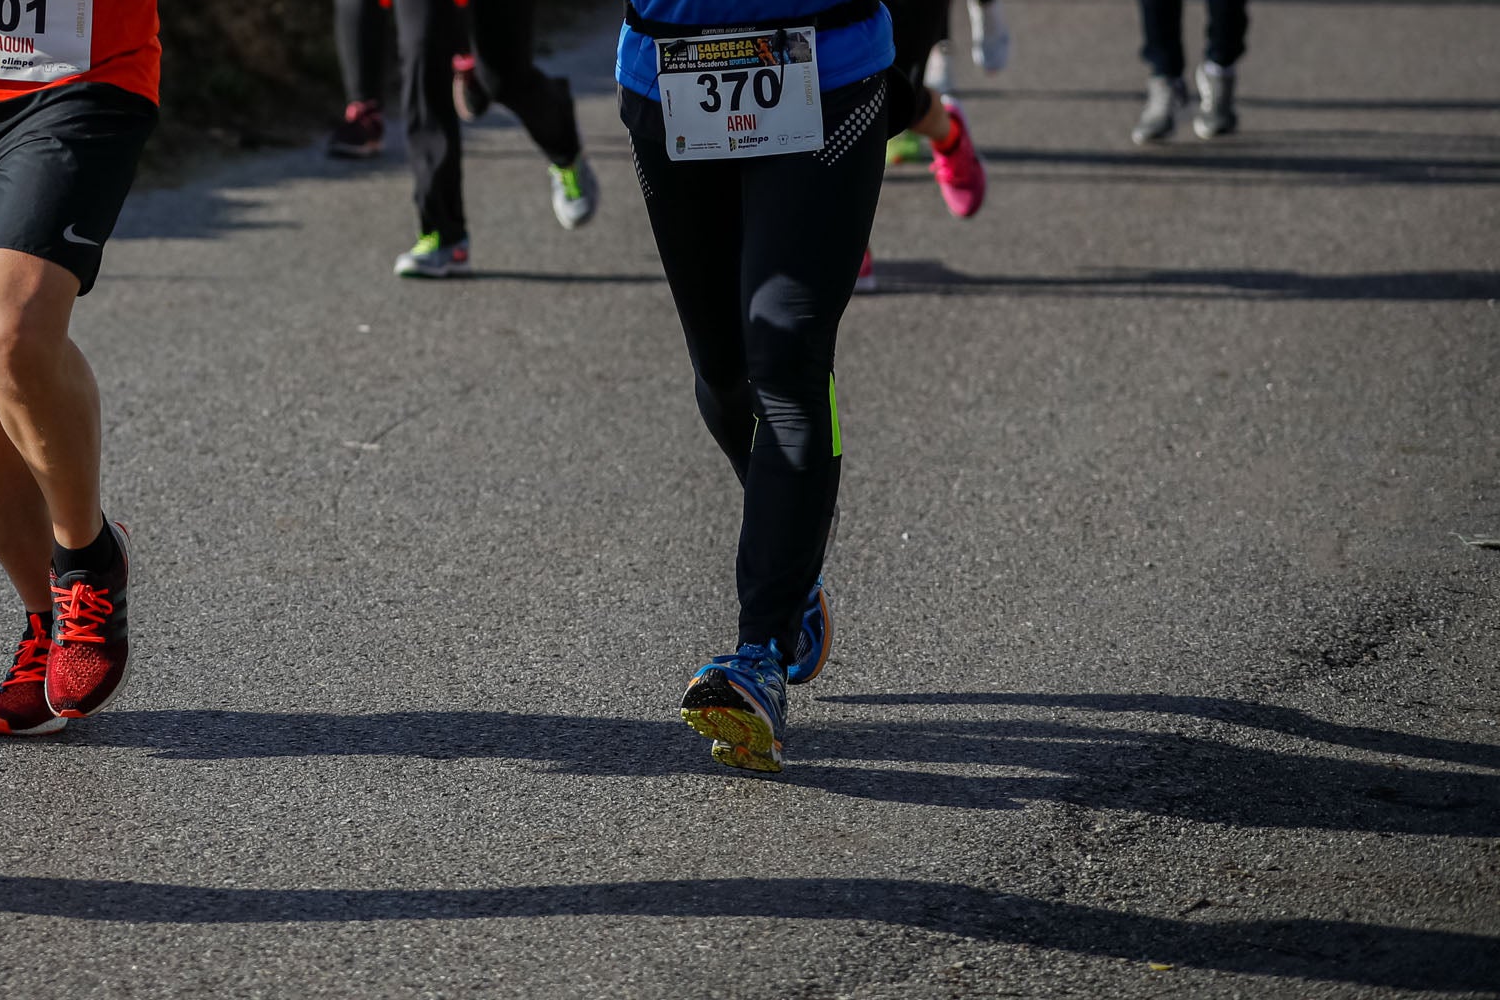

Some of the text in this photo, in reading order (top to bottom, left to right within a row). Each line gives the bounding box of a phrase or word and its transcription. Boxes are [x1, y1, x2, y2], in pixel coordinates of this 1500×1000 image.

[698, 40, 754, 52] CARRERA
[687, 44, 698, 60] VII
[698, 49, 755, 60] POPULAR
[1, 57, 34, 67] olimpo
[687, 60, 696, 68] los
[697, 60, 728, 68] Secaderos
[697, 68, 780, 113] 370
[727, 114, 757, 132] ARNI
[738, 135, 769, 144] olimpo
